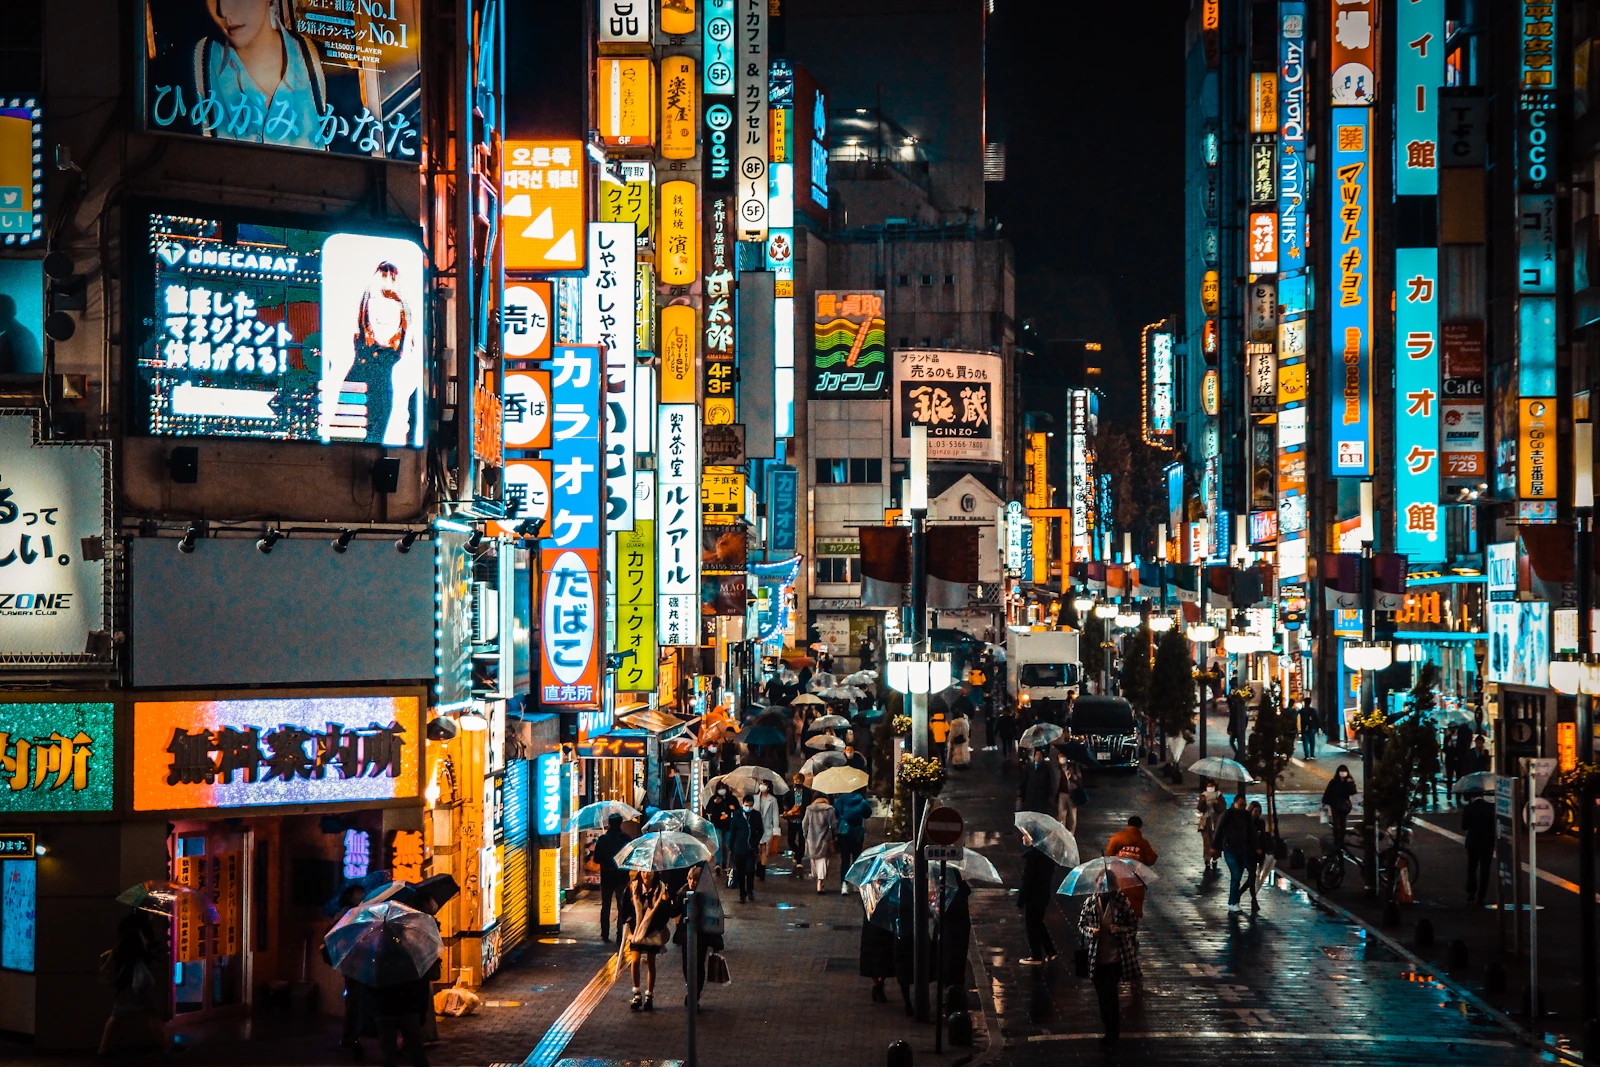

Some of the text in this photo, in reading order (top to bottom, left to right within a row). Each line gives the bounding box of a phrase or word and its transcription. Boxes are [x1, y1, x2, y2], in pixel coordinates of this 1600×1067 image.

[368, 21, 408, 48] No.1
[712, 24, 726, 35] 8F
[712, 69, 726, 79] 5F
[747, 63, 759, 76] &
[154, 85, 417, 156] ひめがみ かなた
[747, 84, 760, 145] カプセル
[618, 136, 631, 145] 6F
[706, 104, 732, 178] Booth
[1340, 127, 1361, 149] 薬
[746, 163, 760, 173] 8F
[746, 206, 760, 216] 5F
[714, 199, 725, 267] 手作り居酒屋
[1340, 163, 1361, 306] マツモトキヨシ
[188, 250, 297, 272] ONECARAT
[596, 231, 617, 350] しゃぶしゃぶ
[705, 269, 734, 352] 甘太郎
[165, 316, 293, 347] マネジメント
[708, 363, 731, 378] 4F
[900, 354, 939, 363] ブランド品
[911, 365, 988, 379] 売るのも 買うのも
[708, 379, 731, 394] 3F
[815, 371, 884, 391] カワノ
[1444, 379, 1482, 394] Cafe
[1406, 275, 1436, 533] カラオケ館
[552, 351, 594, 546] カラオケ
[1449, 461, 1477, 472] 729
[666, 413, 691, 584] 喫茶室 ルノアール
[776, 475, 795, 546] カラオケ
[720, 583, 745, 592] MAO
[553, 567, 588, 667] たばこ
[627, 551, 643, 684] カワノ・クォーク
[668, 597, 680, 644] 磯丸水産
[544, 685, 594, 702] 直売所
[167, 721, 407, 787] 無料案内所
[544, 756, 560, 830] カラオケ
